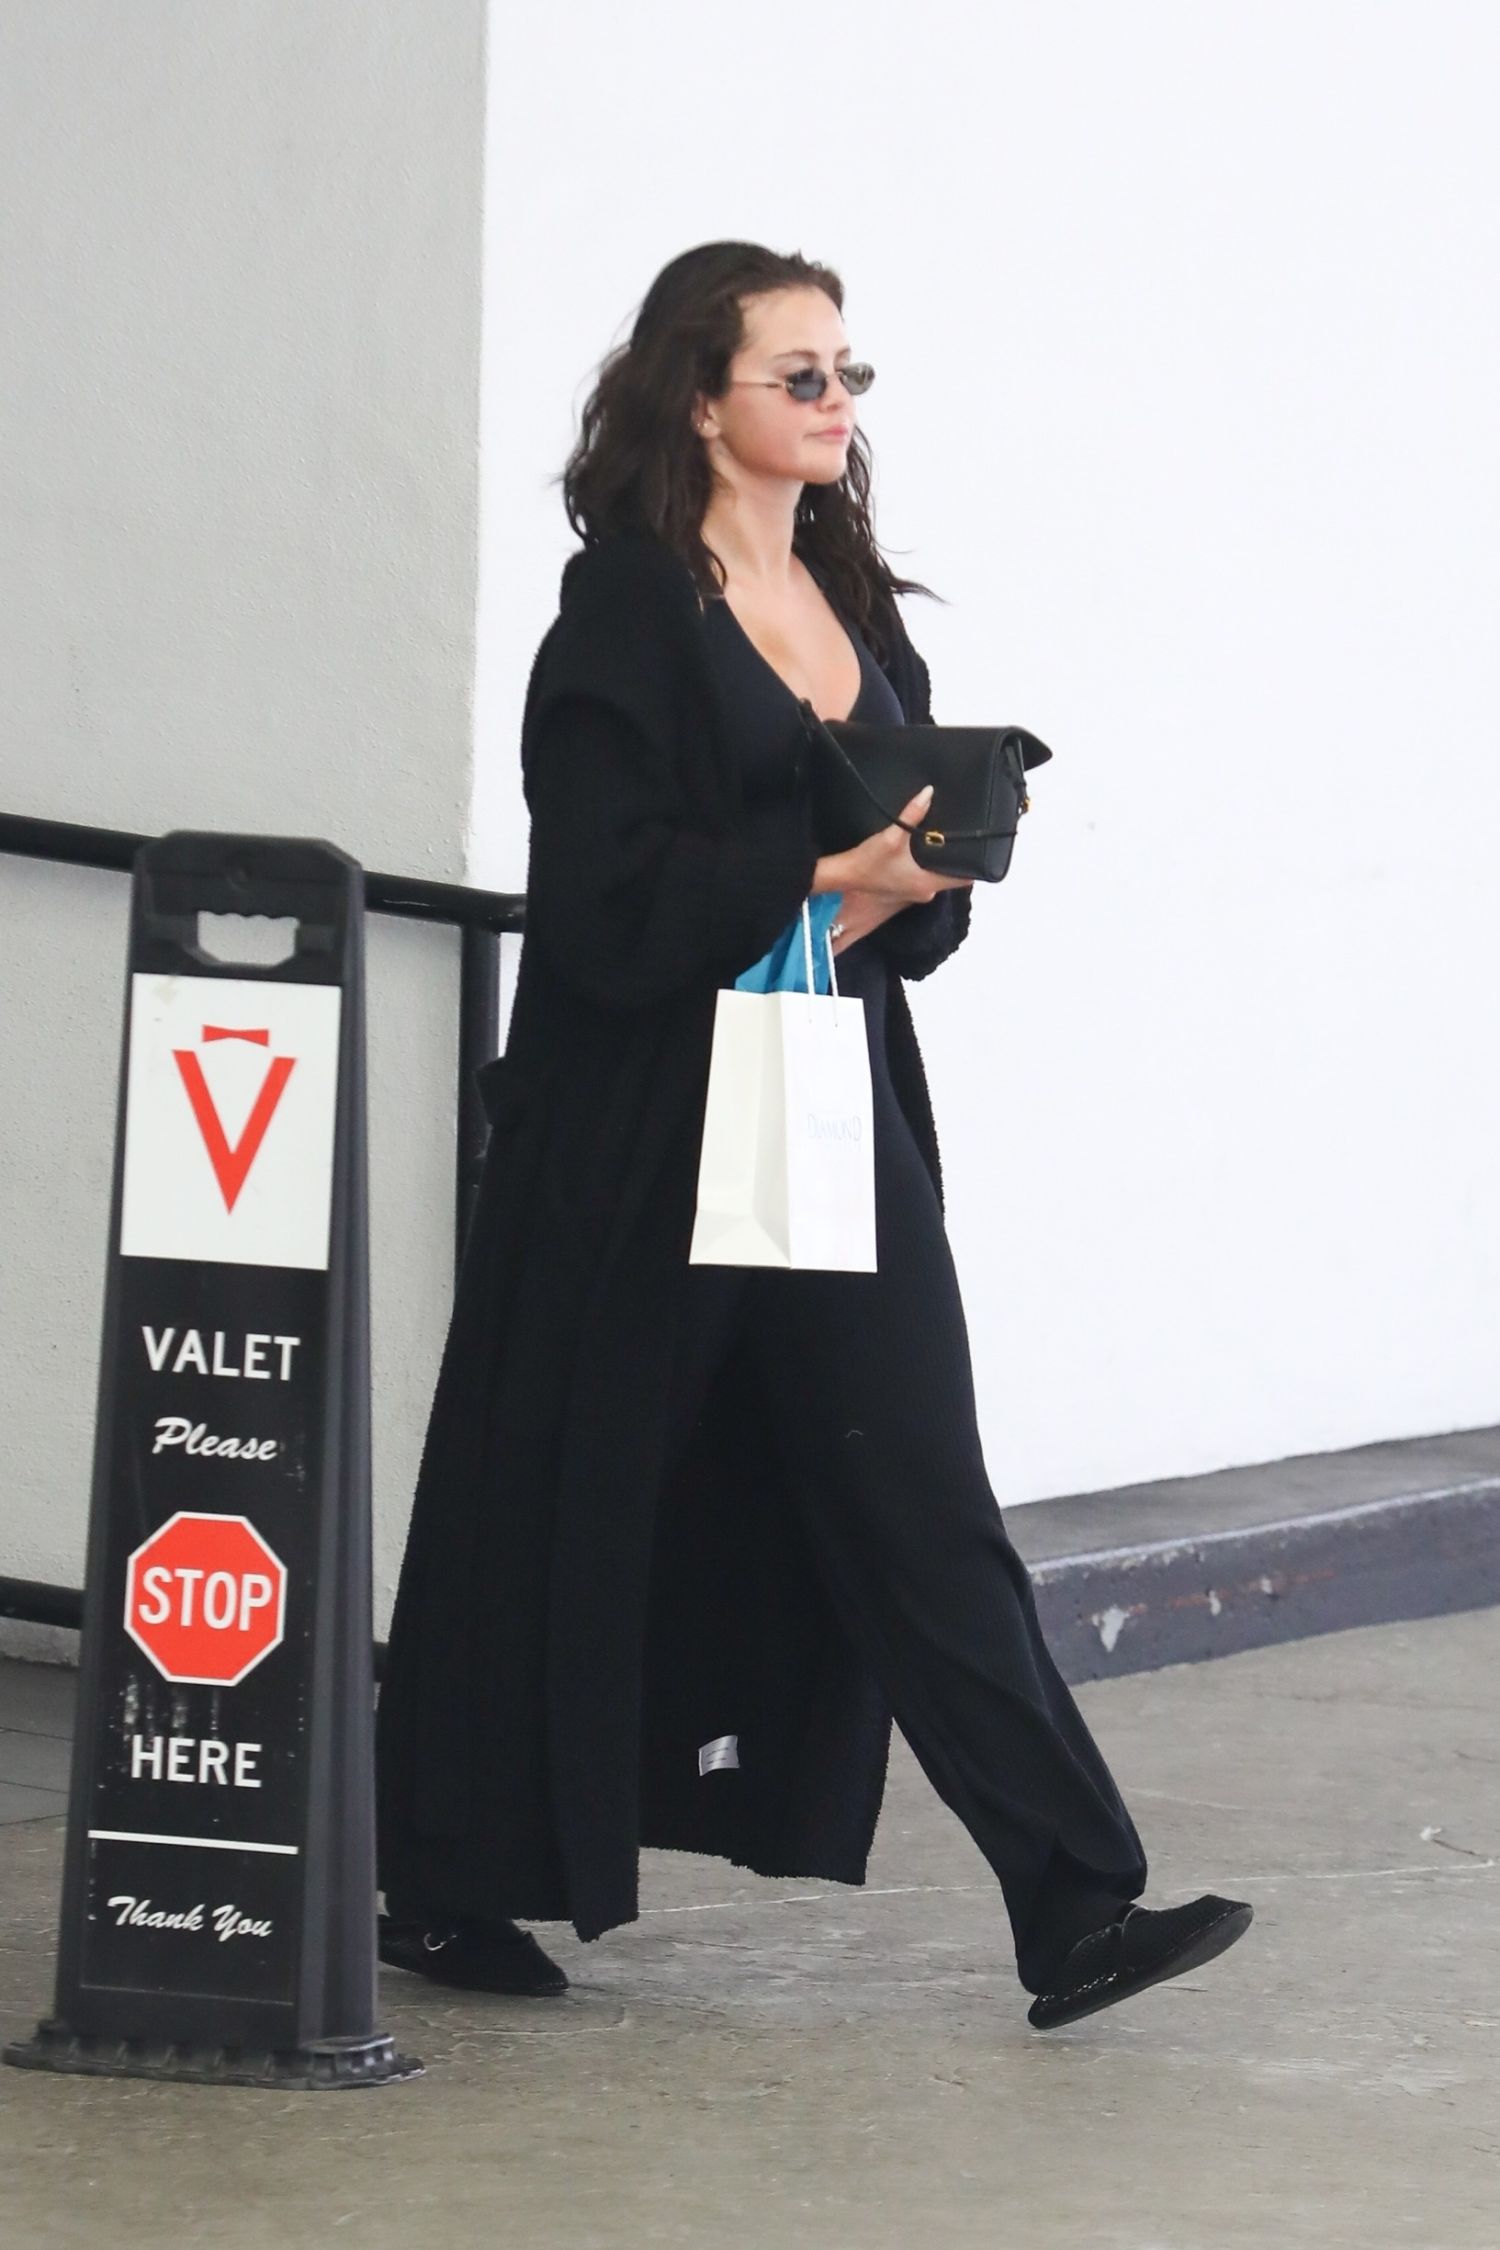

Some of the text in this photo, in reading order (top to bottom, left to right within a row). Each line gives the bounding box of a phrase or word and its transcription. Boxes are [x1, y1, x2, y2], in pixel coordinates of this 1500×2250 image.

[141, 1325, 301, 1381] VALET
[151, 1416, 279, 1461] Please
[138, 1566, 273, 1632] STOP
[130, 1733, 262, 1788] HERE
[107, 1895, 274, 1942] Thank You
